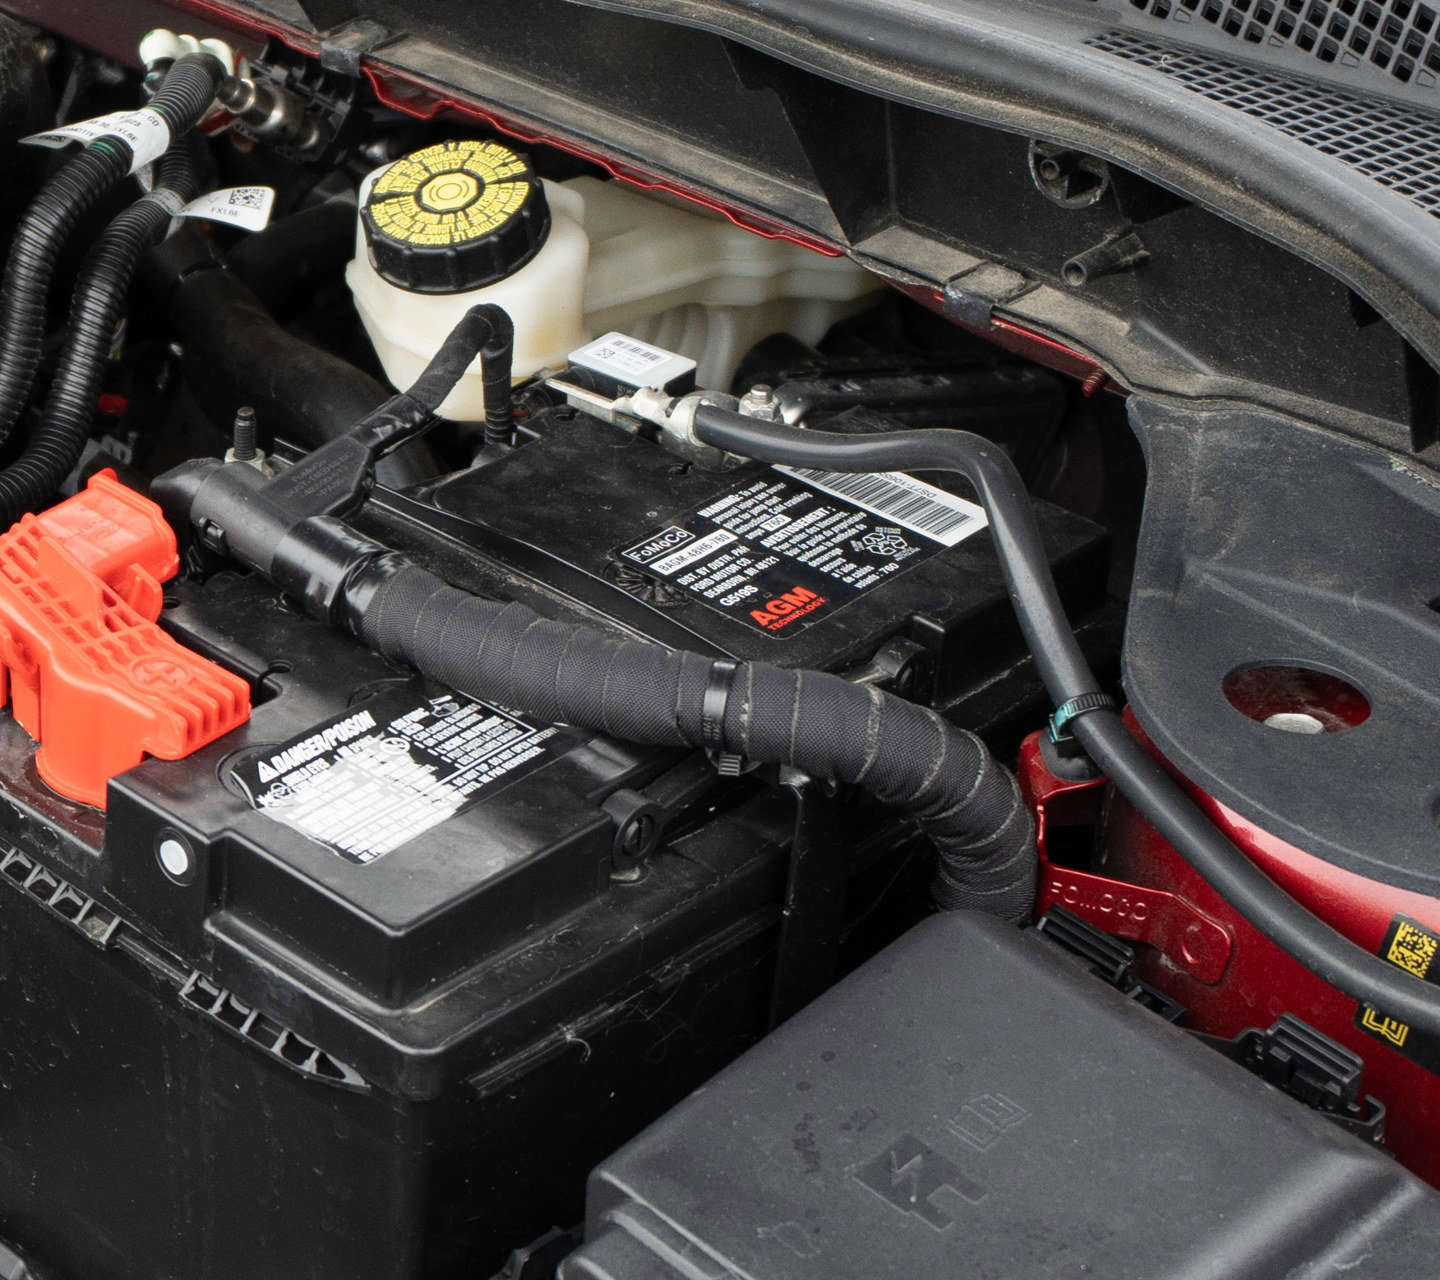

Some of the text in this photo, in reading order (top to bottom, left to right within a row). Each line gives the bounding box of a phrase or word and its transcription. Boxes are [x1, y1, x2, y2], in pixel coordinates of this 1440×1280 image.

[406, 143, 445, 163] SEALED
[447, 141, 455, 151] A
[456, 140, 486, 151] FROM
[483, 143, 513, 159] FLUID
[405, 231, 449, 244] BOUCHON
[452, 229, 467, 242] LE
[465, 211, 510, 239] NETTOYER
[697, 492, 744, 517] WARNING:
[766, 503, 788, 514] Cold
[759, 508, 830, 546] AVERTISSEMENT
[803, 525, 821, 534] des
[629, 530, 688, 560] FoMoCo
[659, 534, 729, 570] BAGM-48H6-760
[675, 545, 751, 585] DIST. BY DISTR. PAR
[689, 556, 754, 591] FORD MOTOR CO.
[702, 555, 780, 598] DEARBORN, MI 48121
[877, 562, 902, 574] 760
[717, 584, 759, 606] G519S
[745, 586, 816, 624] AGM
[768, 598, 827, 629] TECHNOLOGY
[272, 712, 373, 770] DANGER/POISON
[281, 756, 331, 788] SHIELD EYES
[451, 775, 468, 787] DO
[462, 769, 480, 780] NOT
[488, 756, 503, 766] DO
[497, 749, 515, 761] NOT
[510, 740, 533, 754] OPEN
[487, 765, 507, 778] PAS
